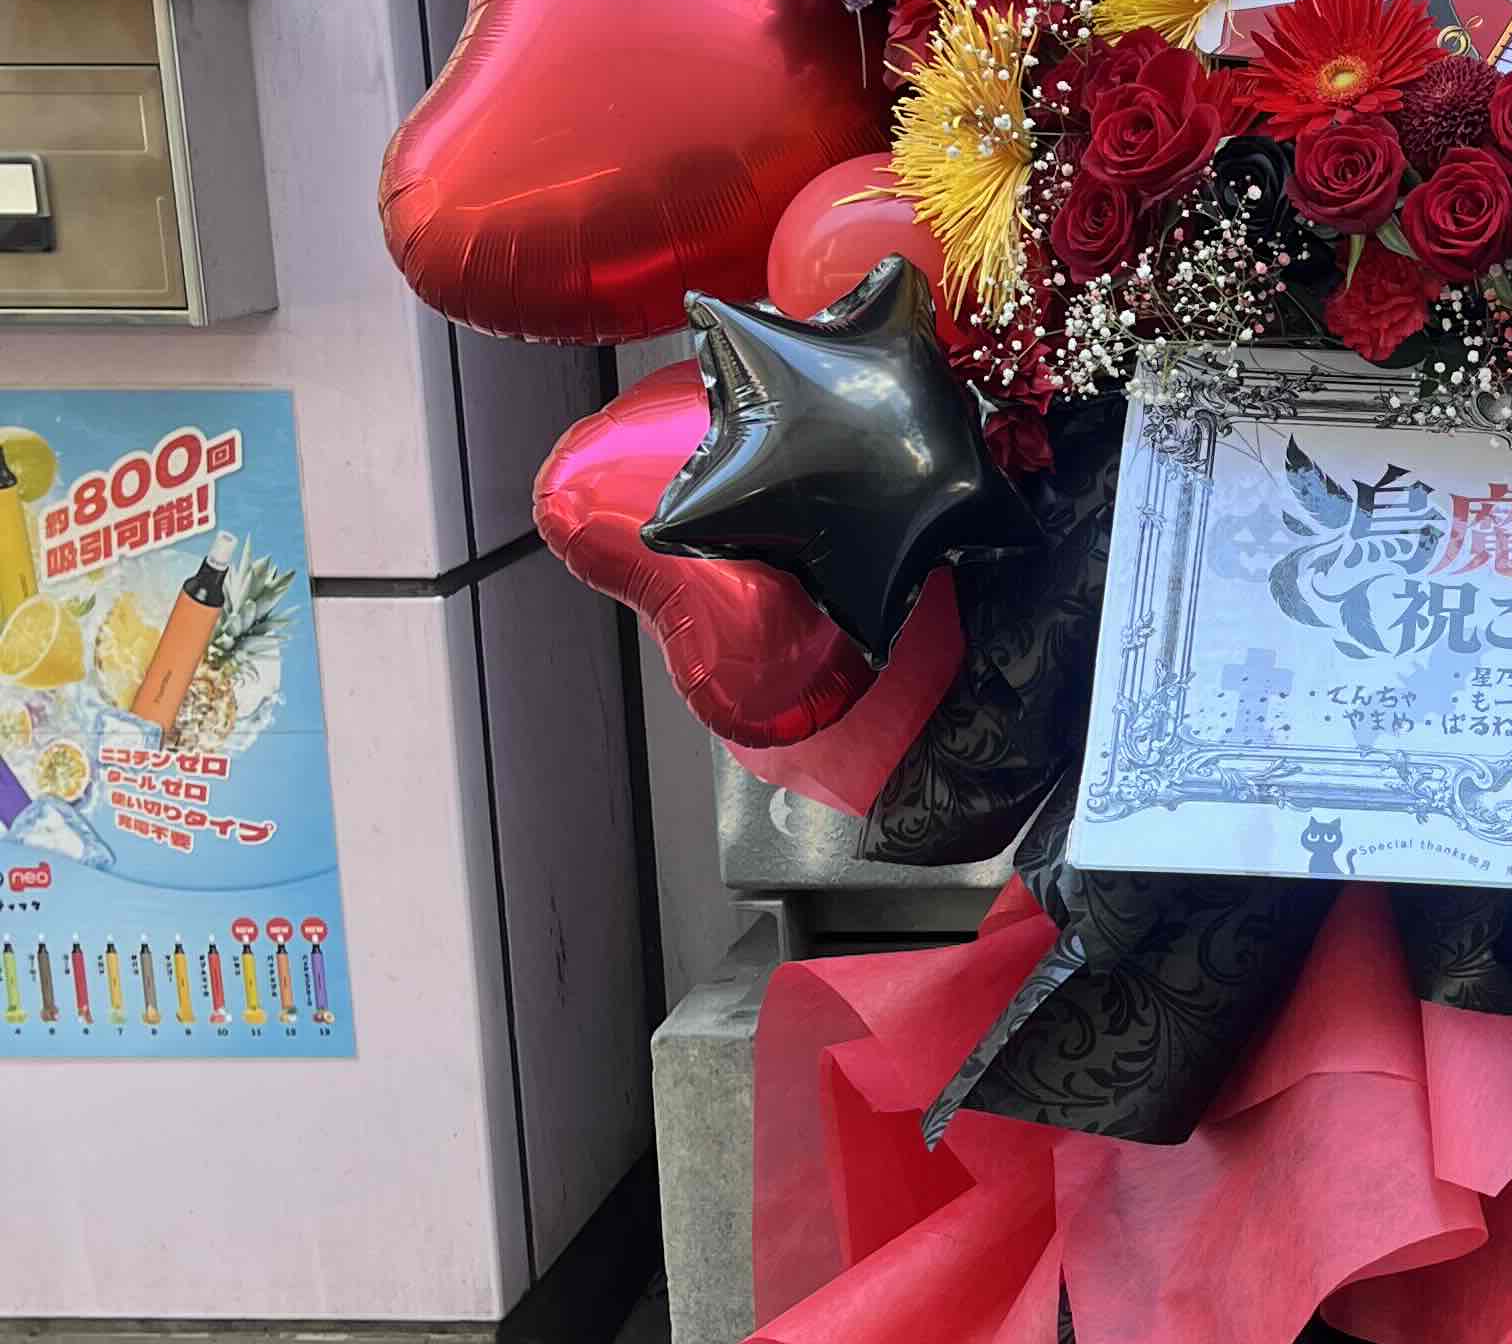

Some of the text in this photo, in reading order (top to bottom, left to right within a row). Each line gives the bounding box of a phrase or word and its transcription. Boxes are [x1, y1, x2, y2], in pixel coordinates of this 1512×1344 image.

[100, 747, 230, 777] ニコチン ゼロ
[161, 777, 209, 803] ゼロ
